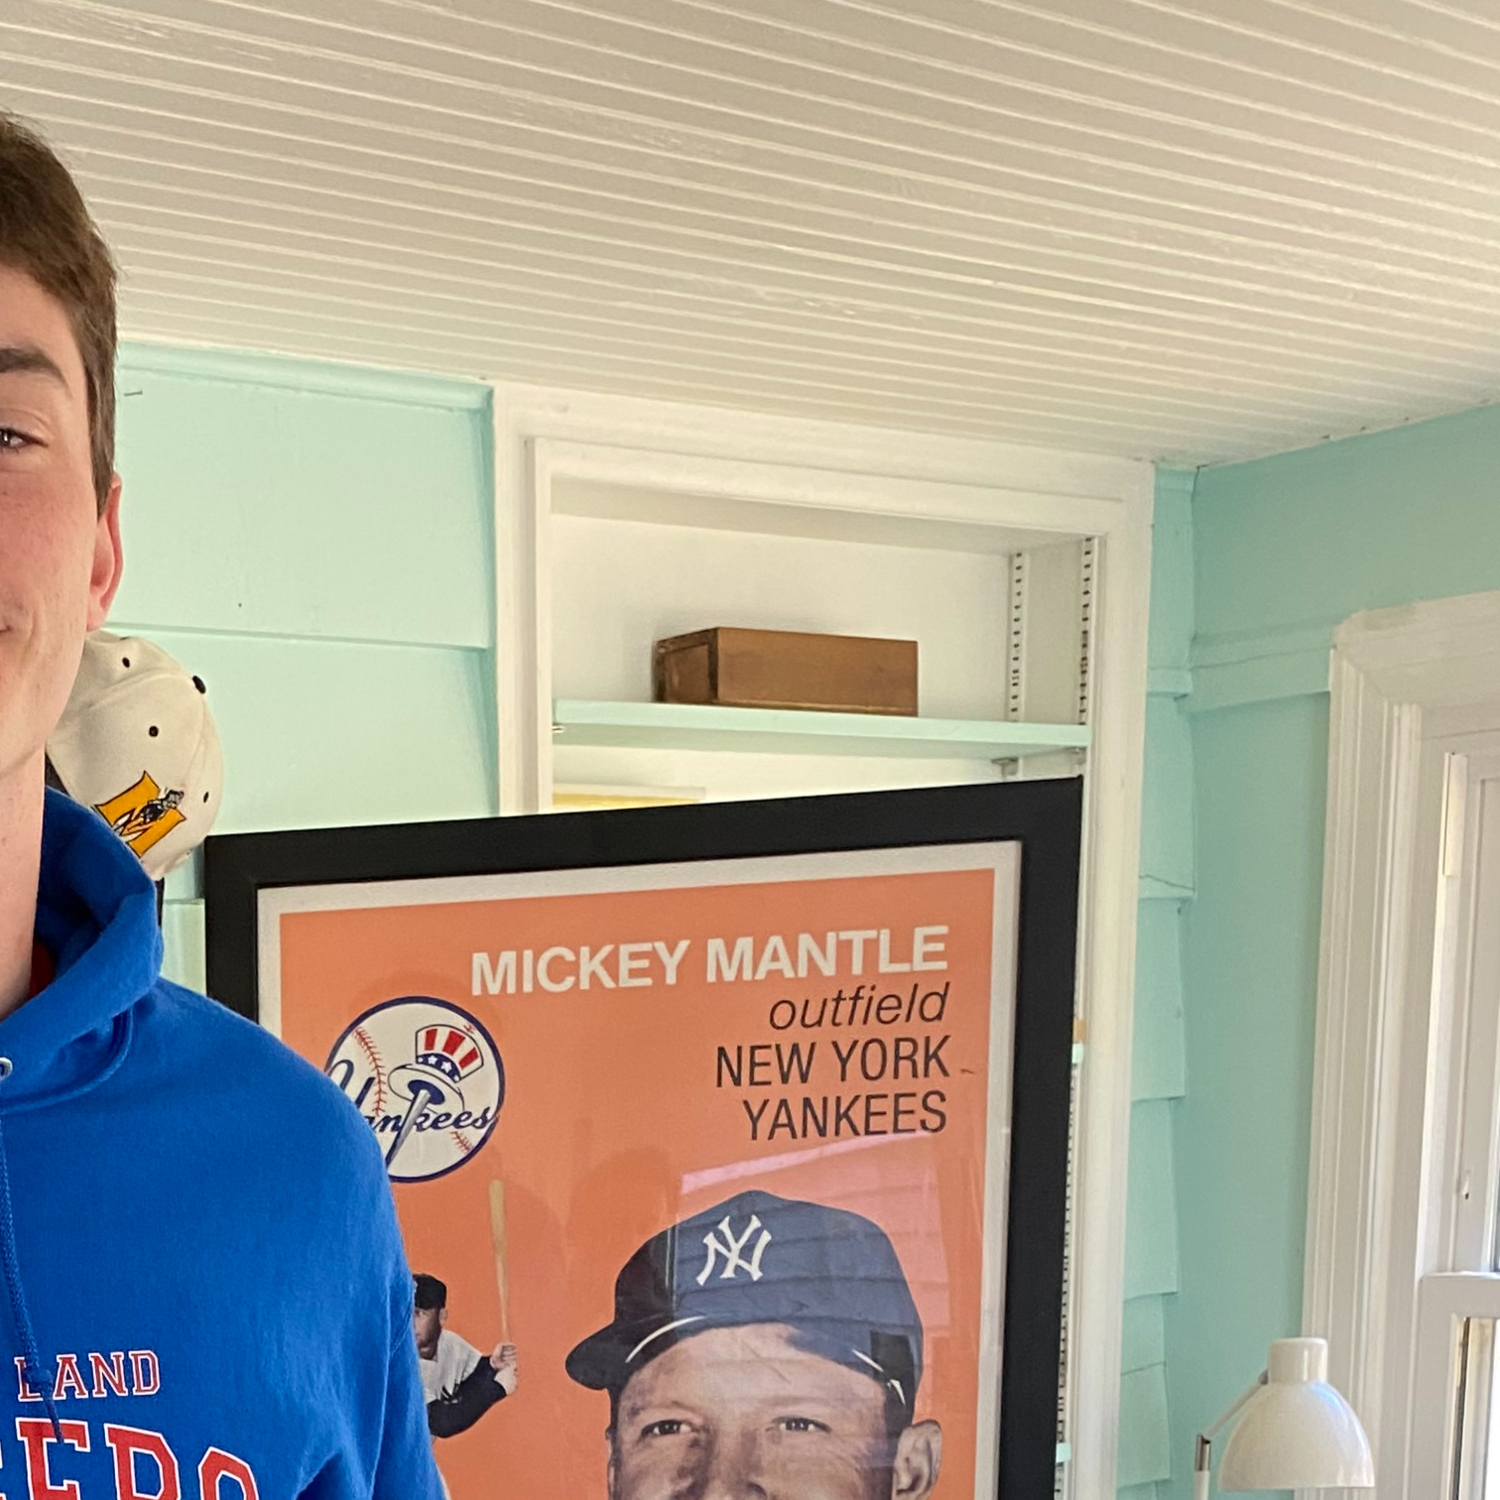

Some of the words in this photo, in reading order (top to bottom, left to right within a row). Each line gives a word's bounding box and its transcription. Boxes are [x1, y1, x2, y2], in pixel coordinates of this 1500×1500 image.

[470, 939, 691, 996] MICKEY
[705, 925, 949, 983] MANTLE
[768, 981, 950, 1031] outfield
[714, 1040, 817, 1088] NEW
[830, 1035, 951, 1082] YORK
[742, 1091, 948, 1141] YANKEES
[13, 1349, 161, 1402] LAND
